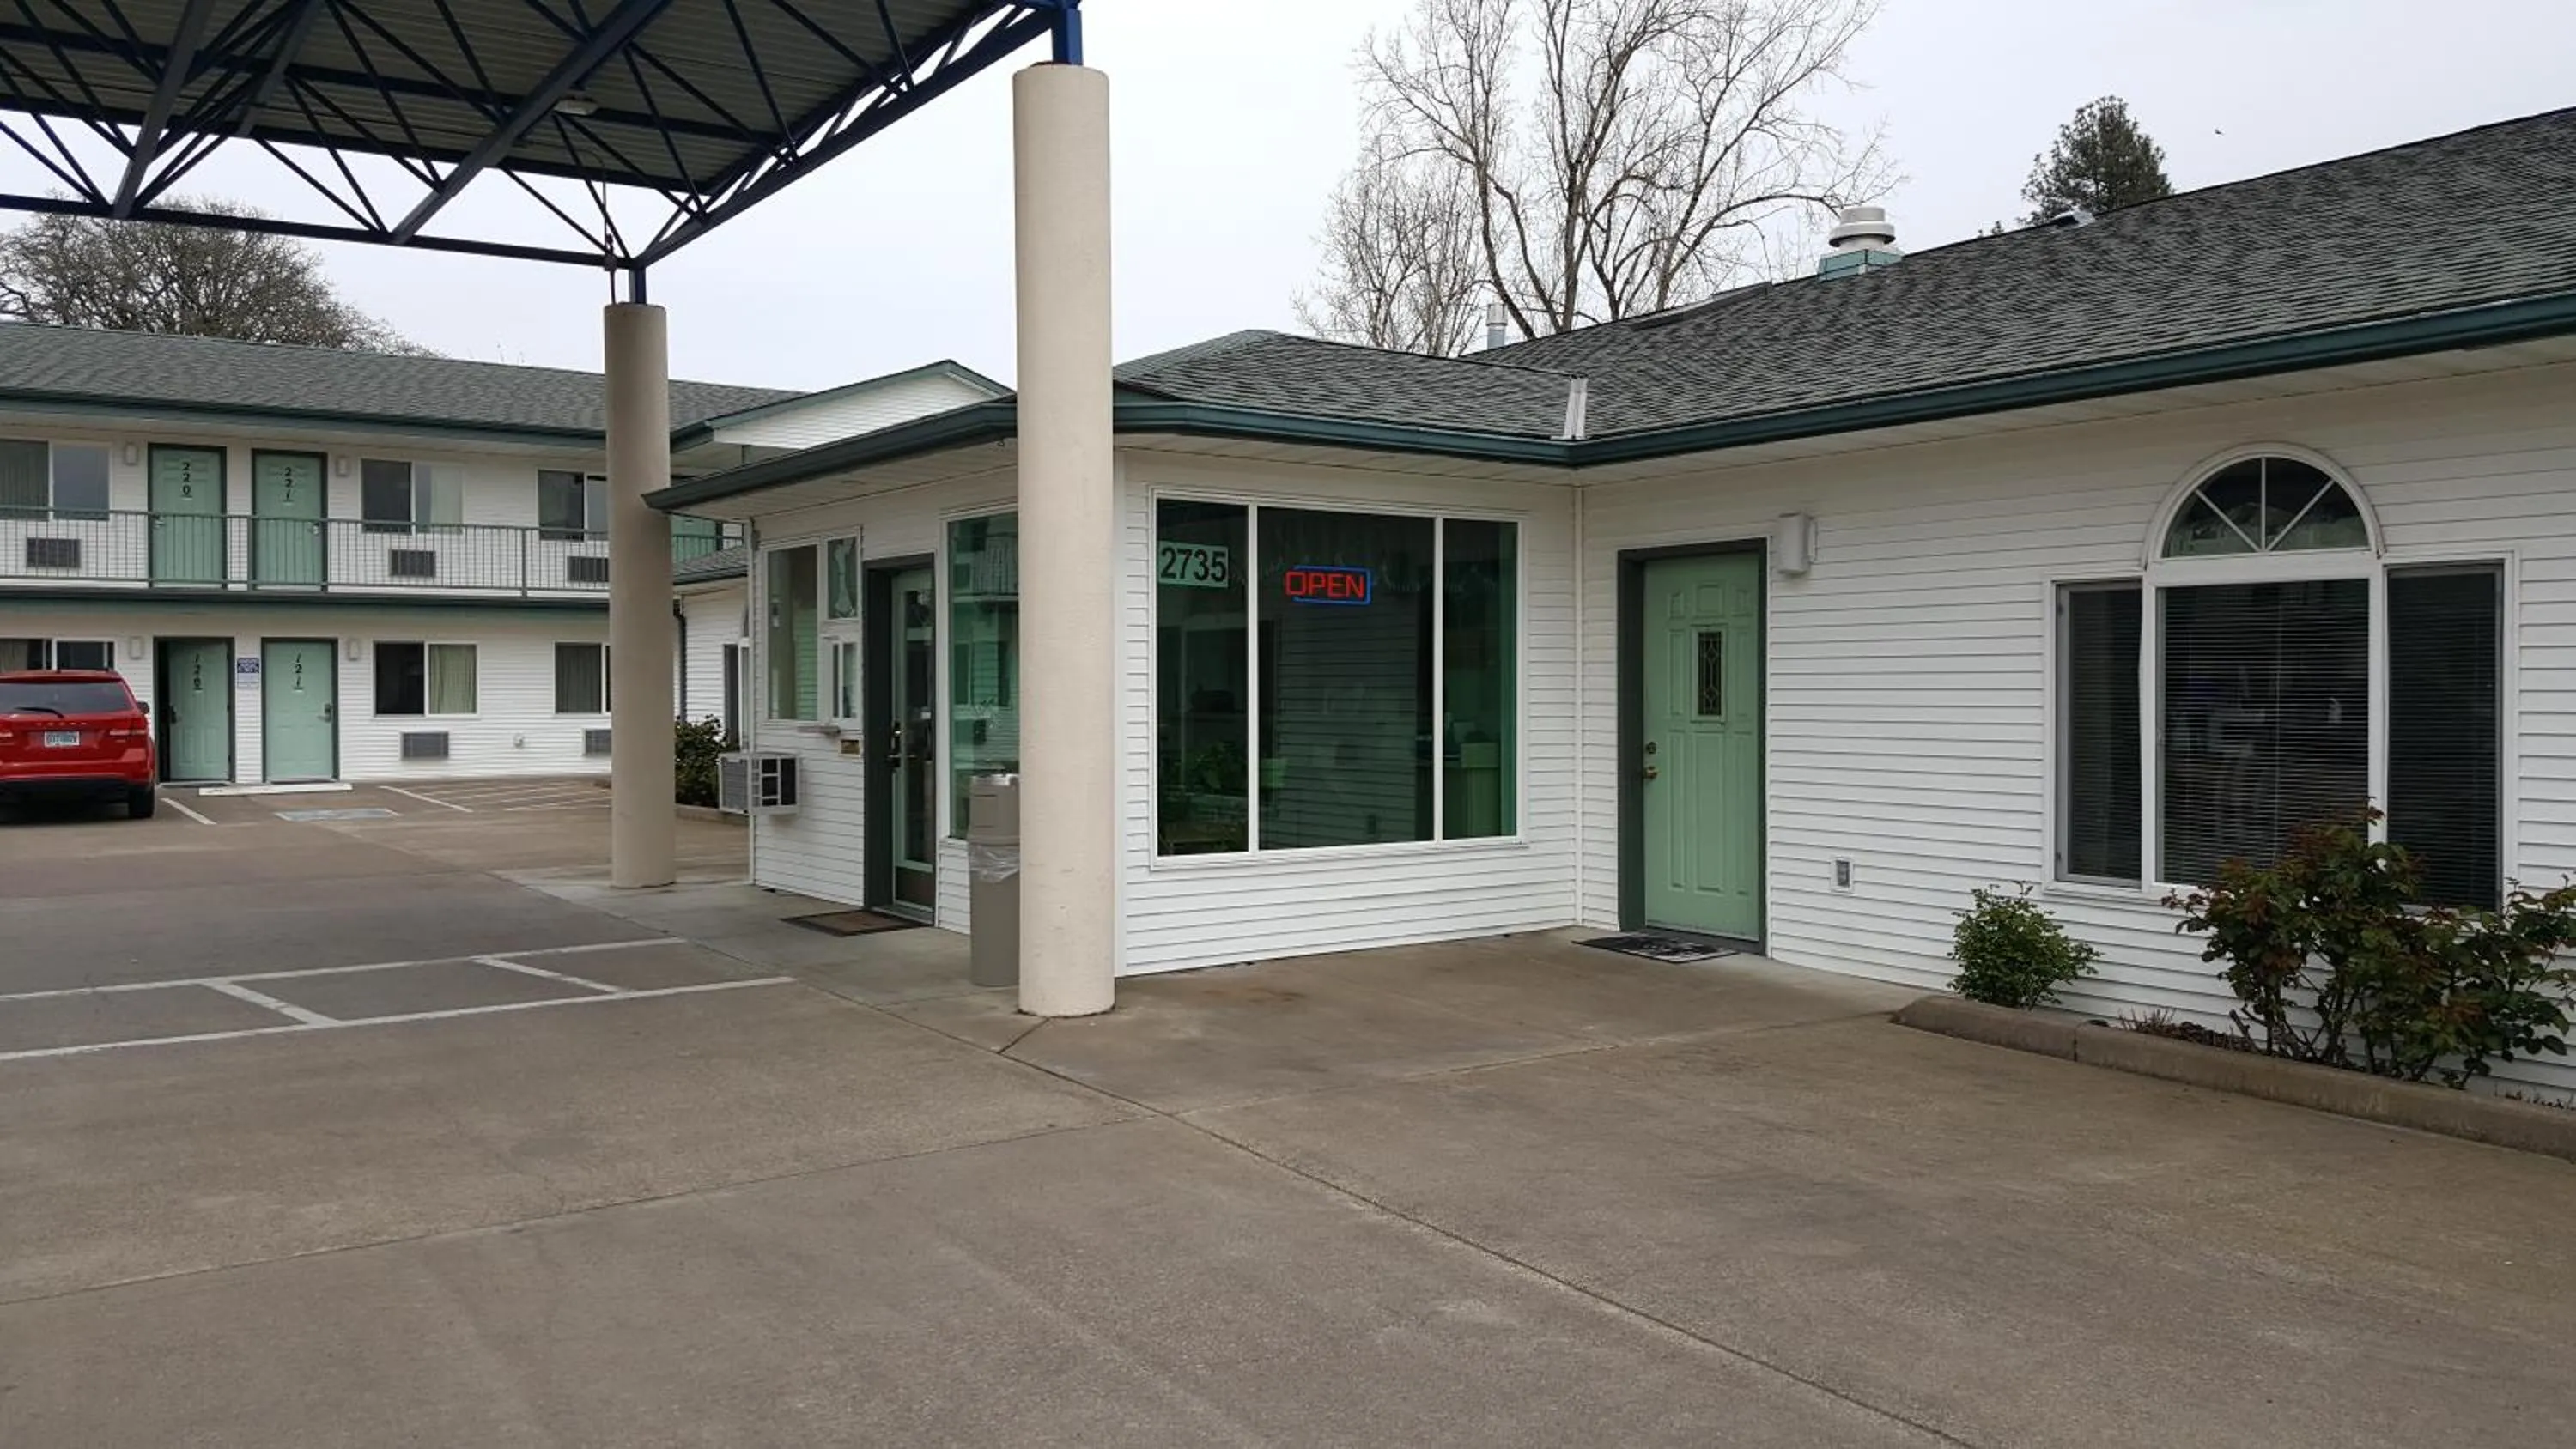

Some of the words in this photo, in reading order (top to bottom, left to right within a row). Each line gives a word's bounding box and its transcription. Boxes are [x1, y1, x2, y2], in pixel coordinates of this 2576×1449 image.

[181, 461, 191, 495] 220
[1160, 548, 1227, 582] 2735
[1285, 570, 1365, 599] OPEN
